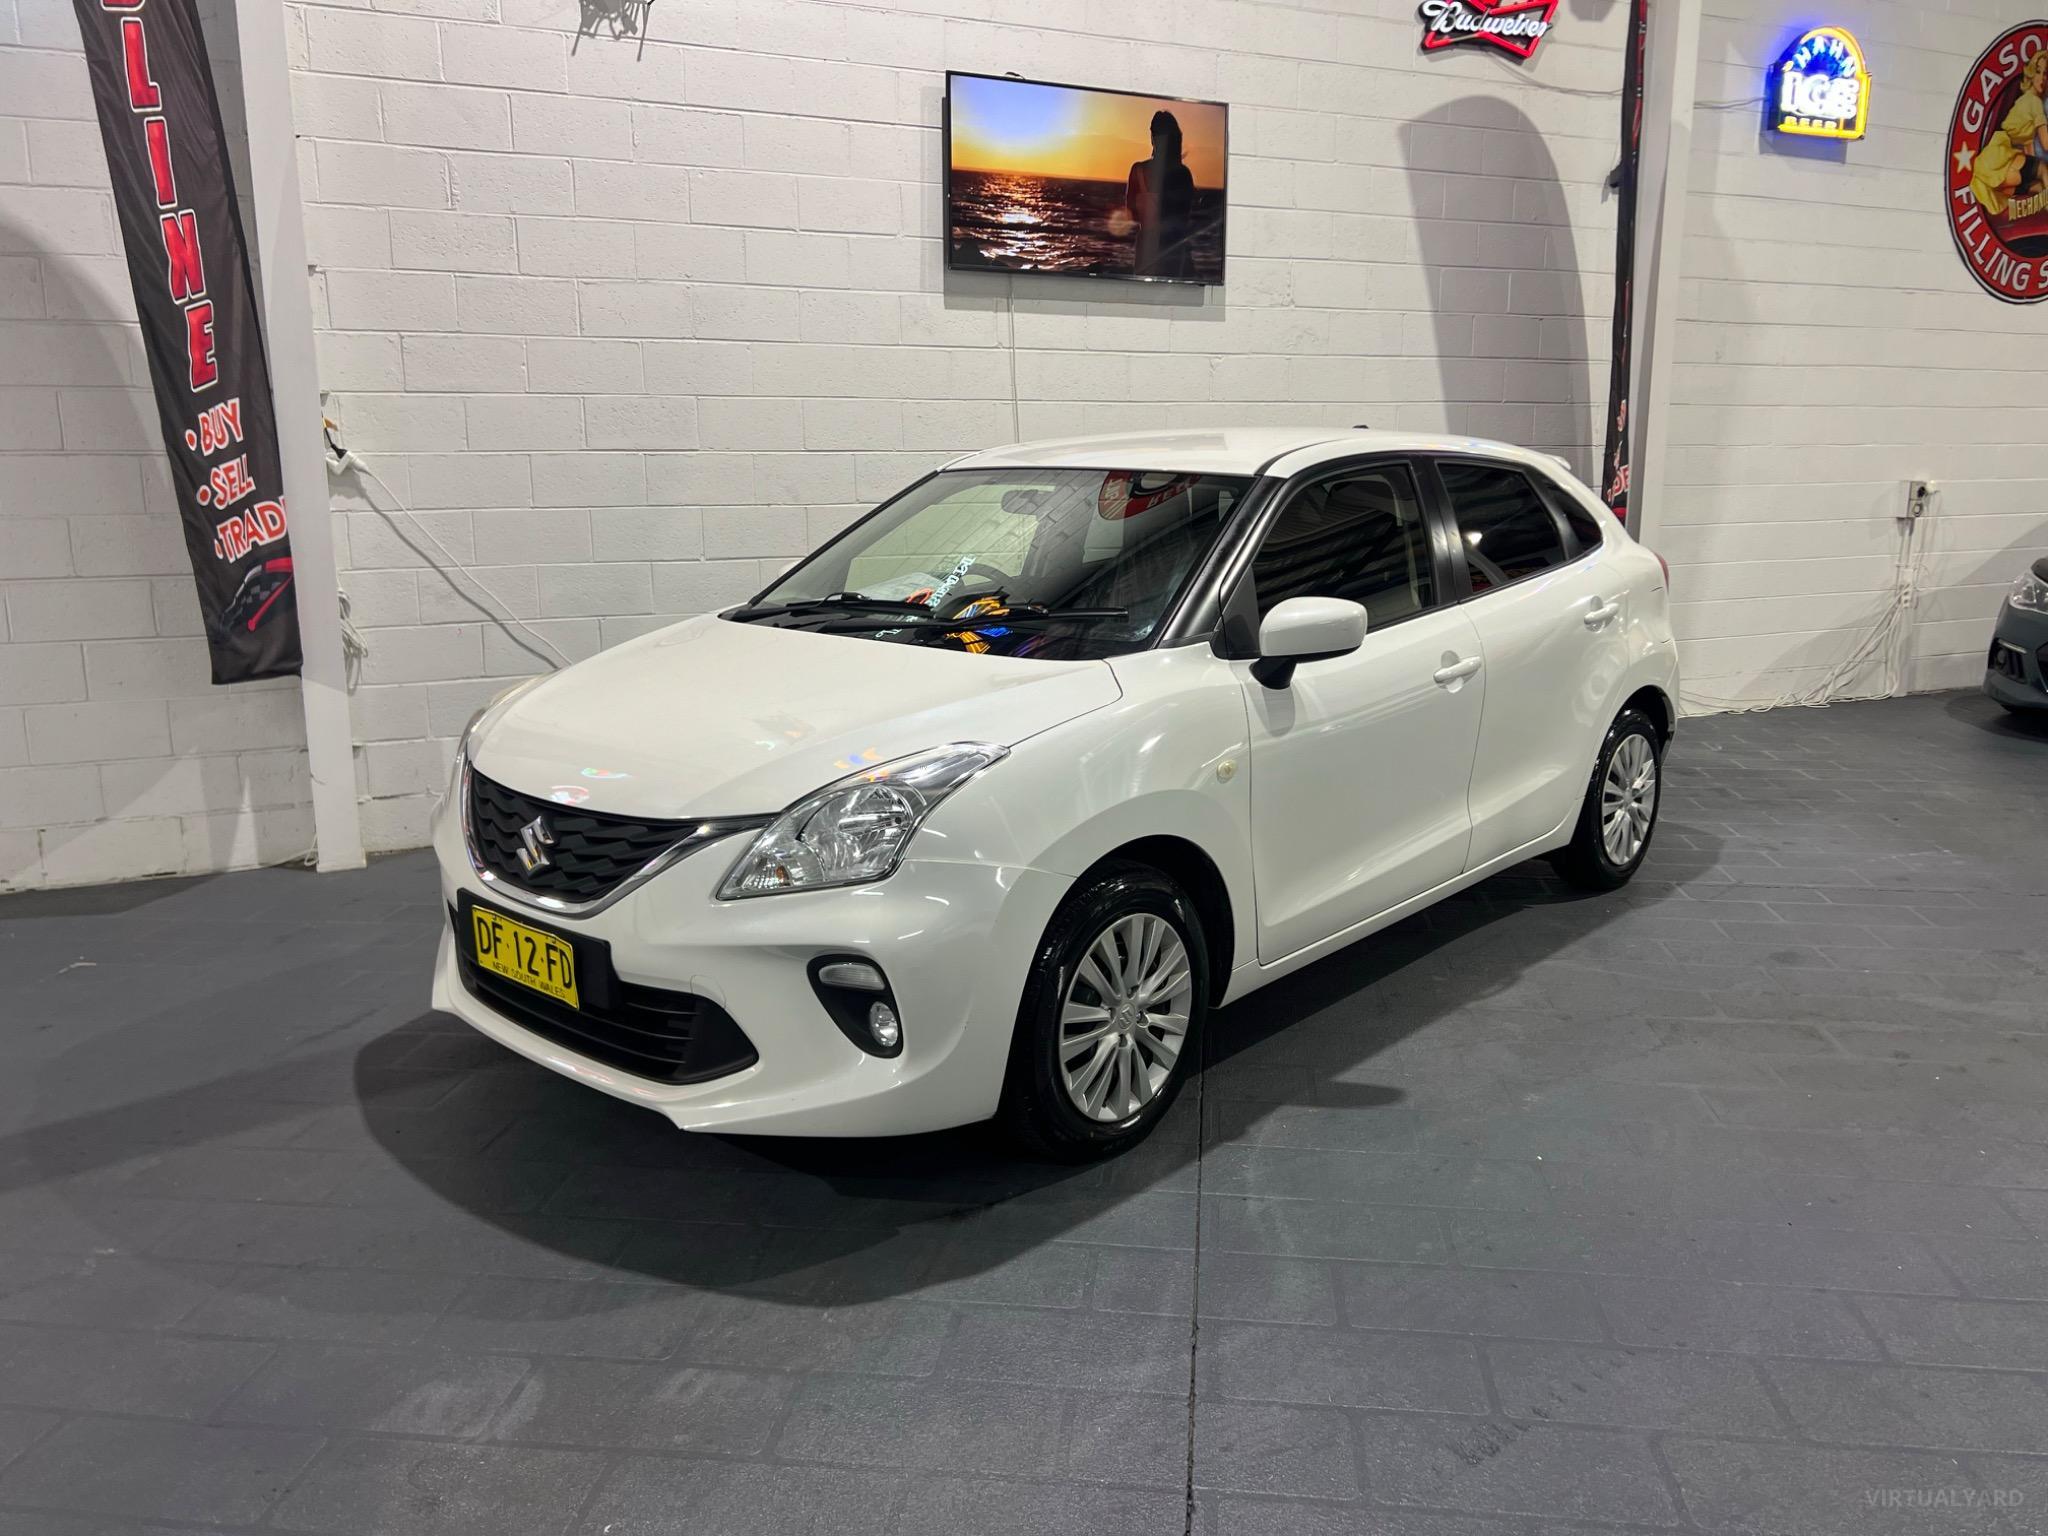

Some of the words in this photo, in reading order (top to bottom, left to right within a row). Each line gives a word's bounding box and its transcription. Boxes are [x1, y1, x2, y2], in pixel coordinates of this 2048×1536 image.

[1422, 0, 1552, 38] Budweiser
[100, 0, 218, 392] LINE
[1955, 188, 2032, 292] FILLING
[197, 397, 244, 456] BUY
[209, 453, 257, 510] SELL
[216, 495, 288, 563] TRAD
[493, 962, 508, 974] NEW
[511, 969, 537, 984] SOUTH
[539, 981, 566, 997] WALES
